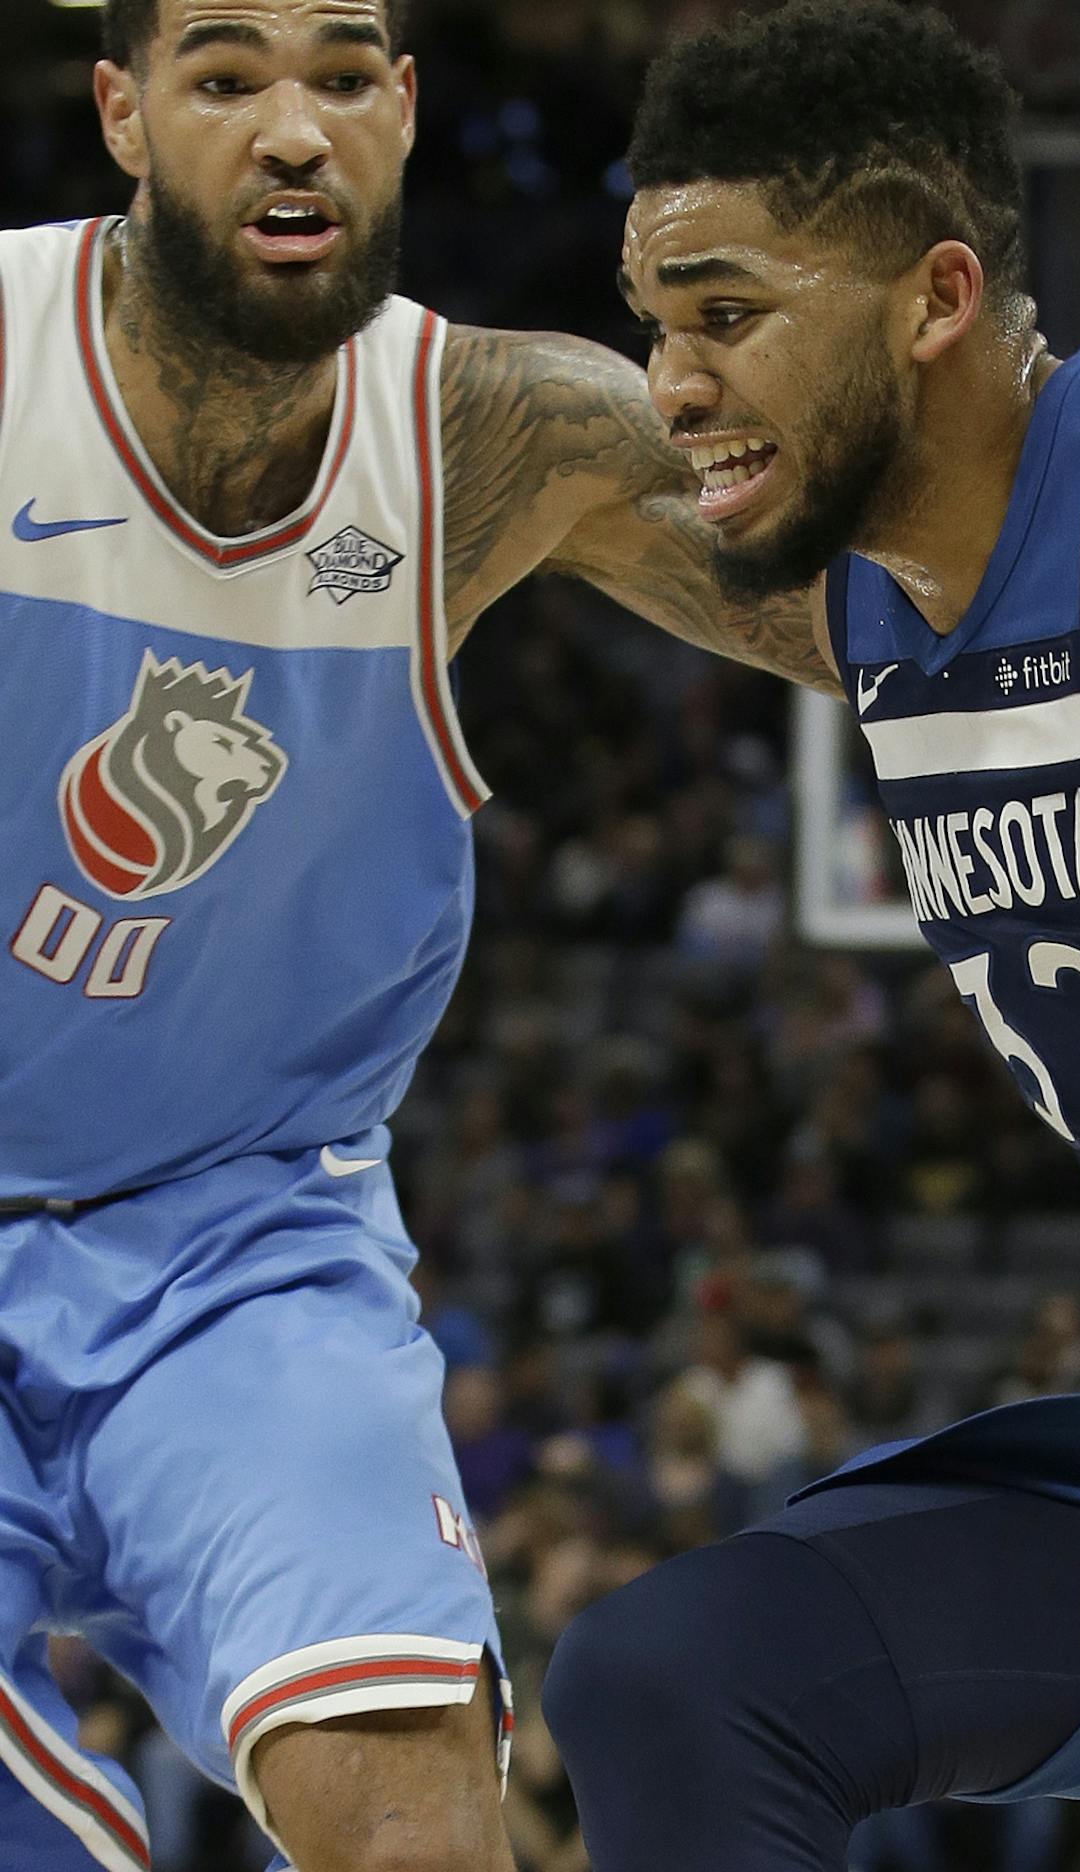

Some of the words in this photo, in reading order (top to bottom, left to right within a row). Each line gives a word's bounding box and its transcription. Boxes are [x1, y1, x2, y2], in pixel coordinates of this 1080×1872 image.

[316, 552, 388, 569] DIAMOND
[1022, 651, 1071, 689] fitbit
[9, 879, 173, 998] 00
